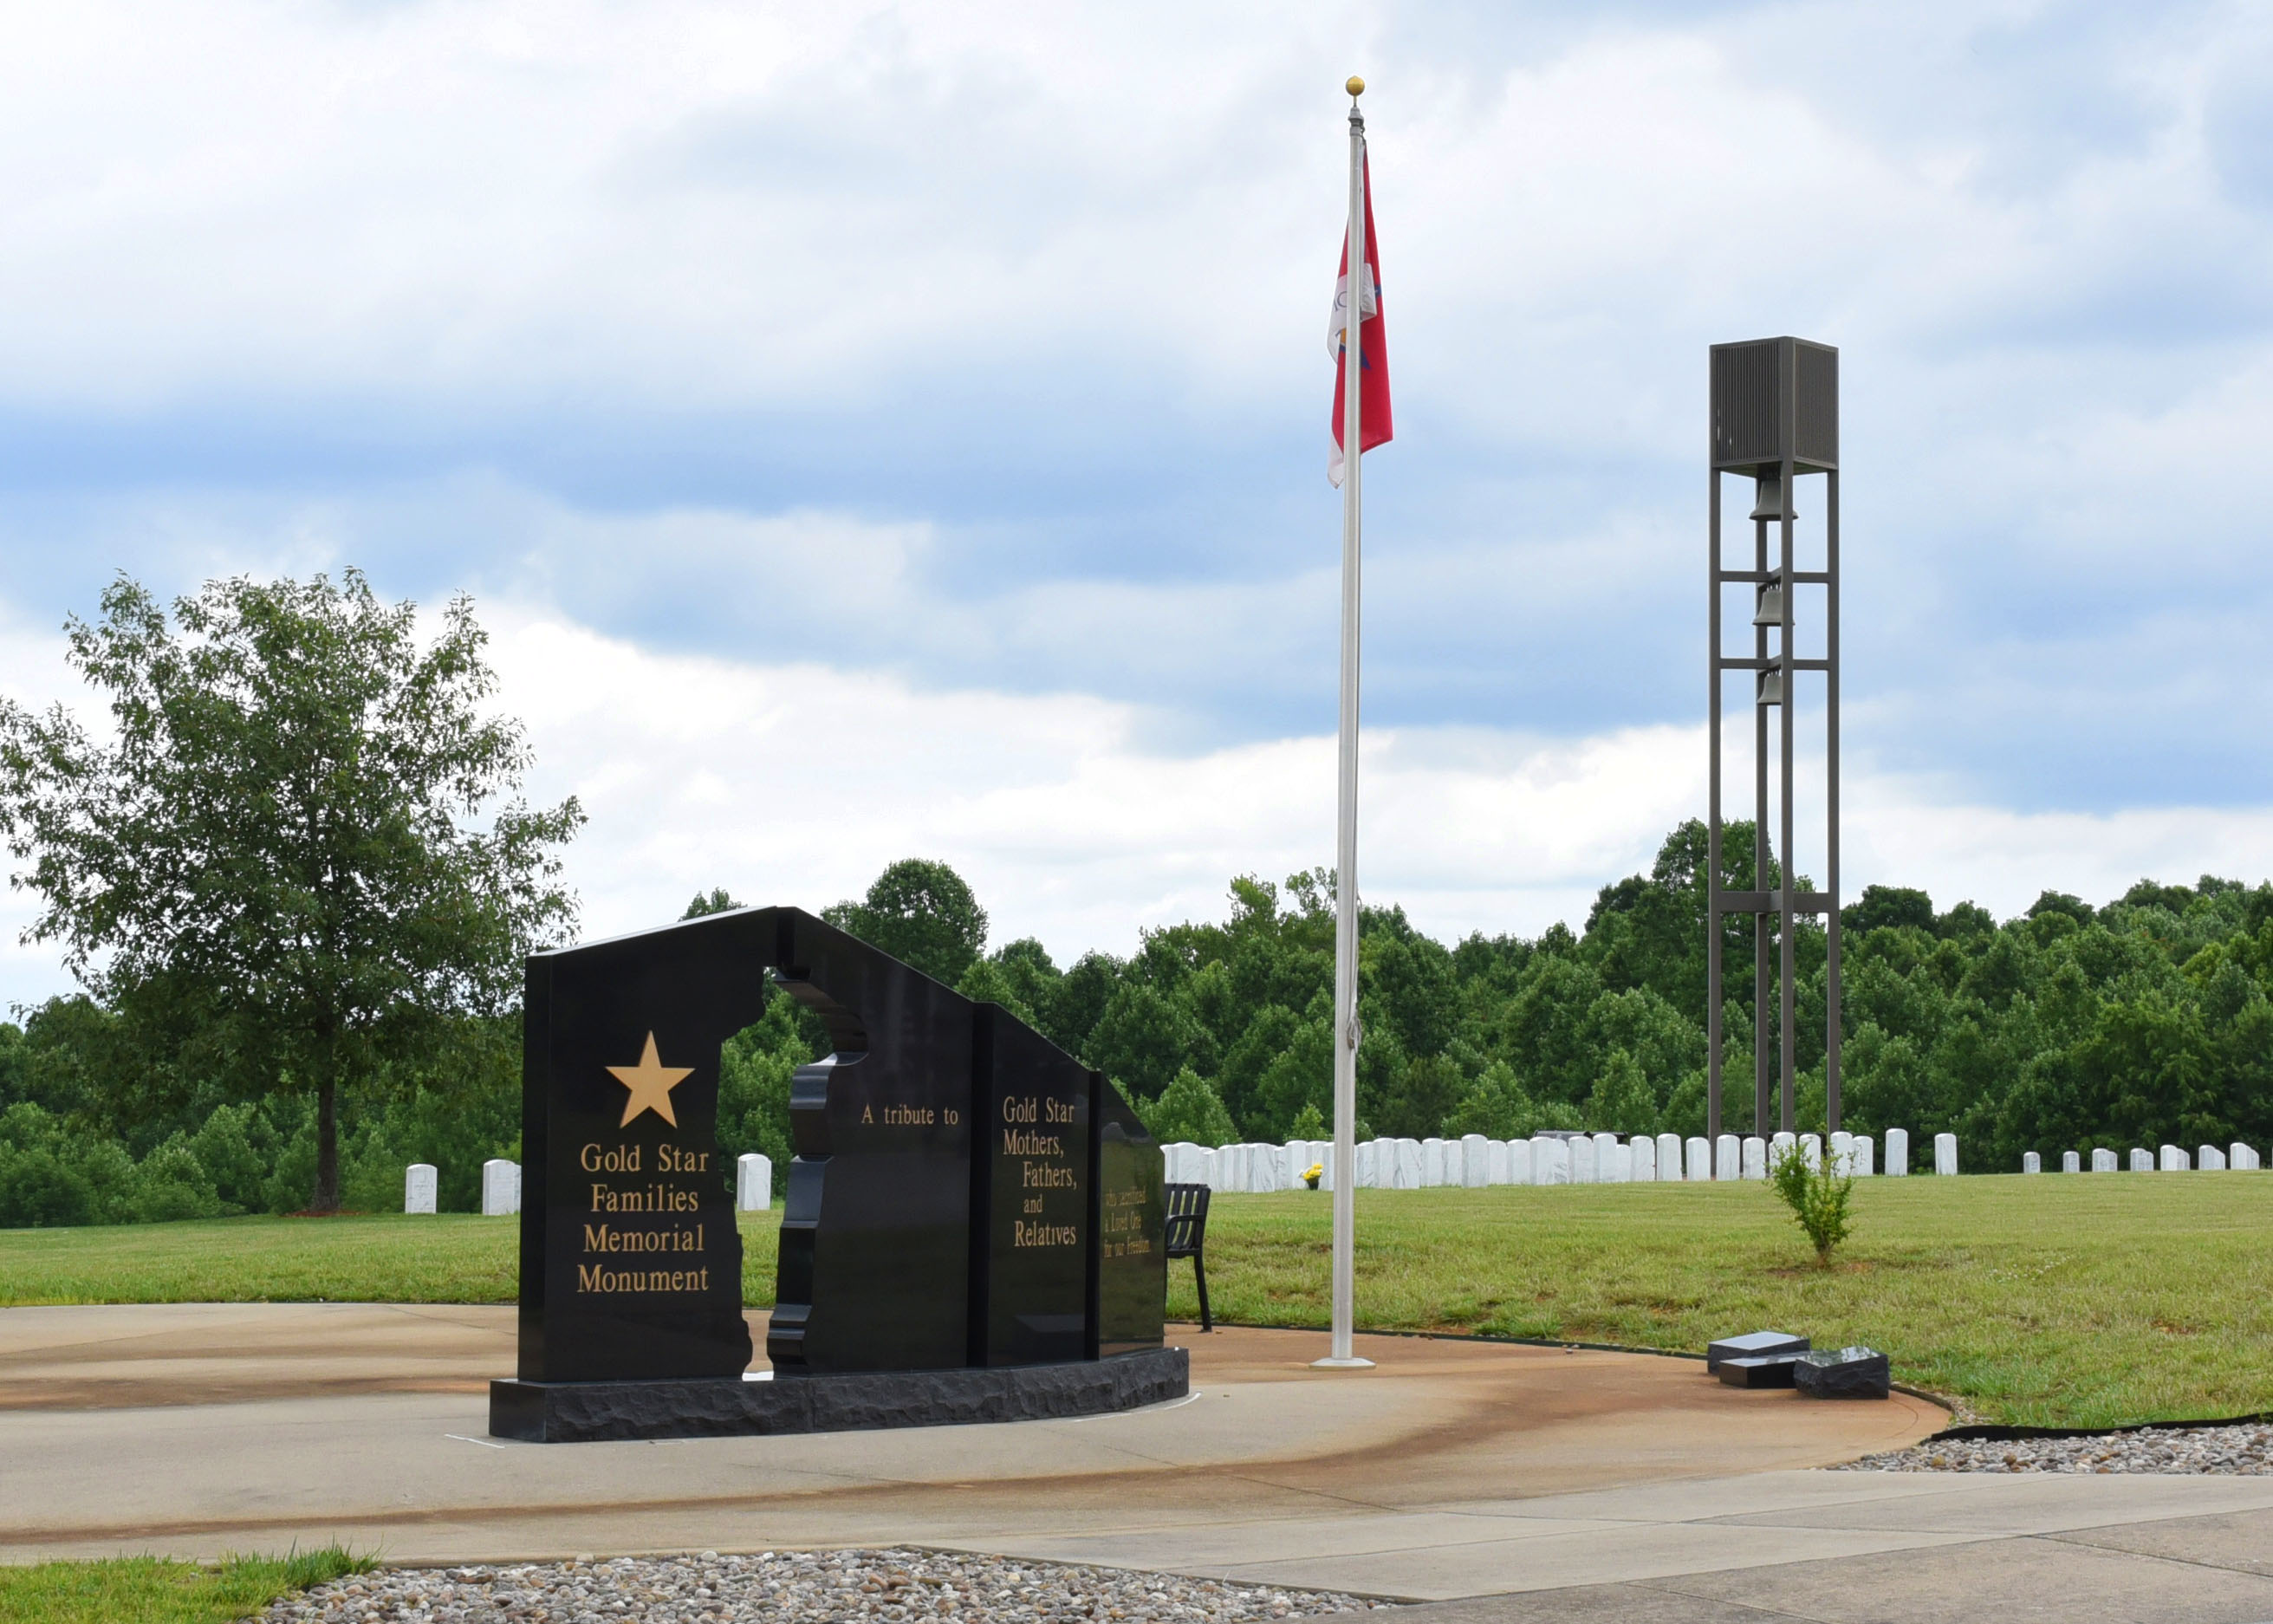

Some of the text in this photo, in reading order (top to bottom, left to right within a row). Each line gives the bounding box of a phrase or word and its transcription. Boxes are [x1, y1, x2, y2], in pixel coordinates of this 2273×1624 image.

[860, 1103, 959, 1126] A tribute to
[1003, 1095, 1075, 1124] Gold Star
[580, 1142, 710, 1173] Gold Star
[1003, 1128, 1065, 1160] Mothers,
[1023, 1160, 1077, 1191] Fathers,
[590, 1183, 699, 1212] Families
[1023, 1193, 1043, 1215] and
[582, 1223, 705, 1253] Memorial
[1014, 1219, 1077, 1249] Relatives
[577, 1263, 709, 1294] Monument
